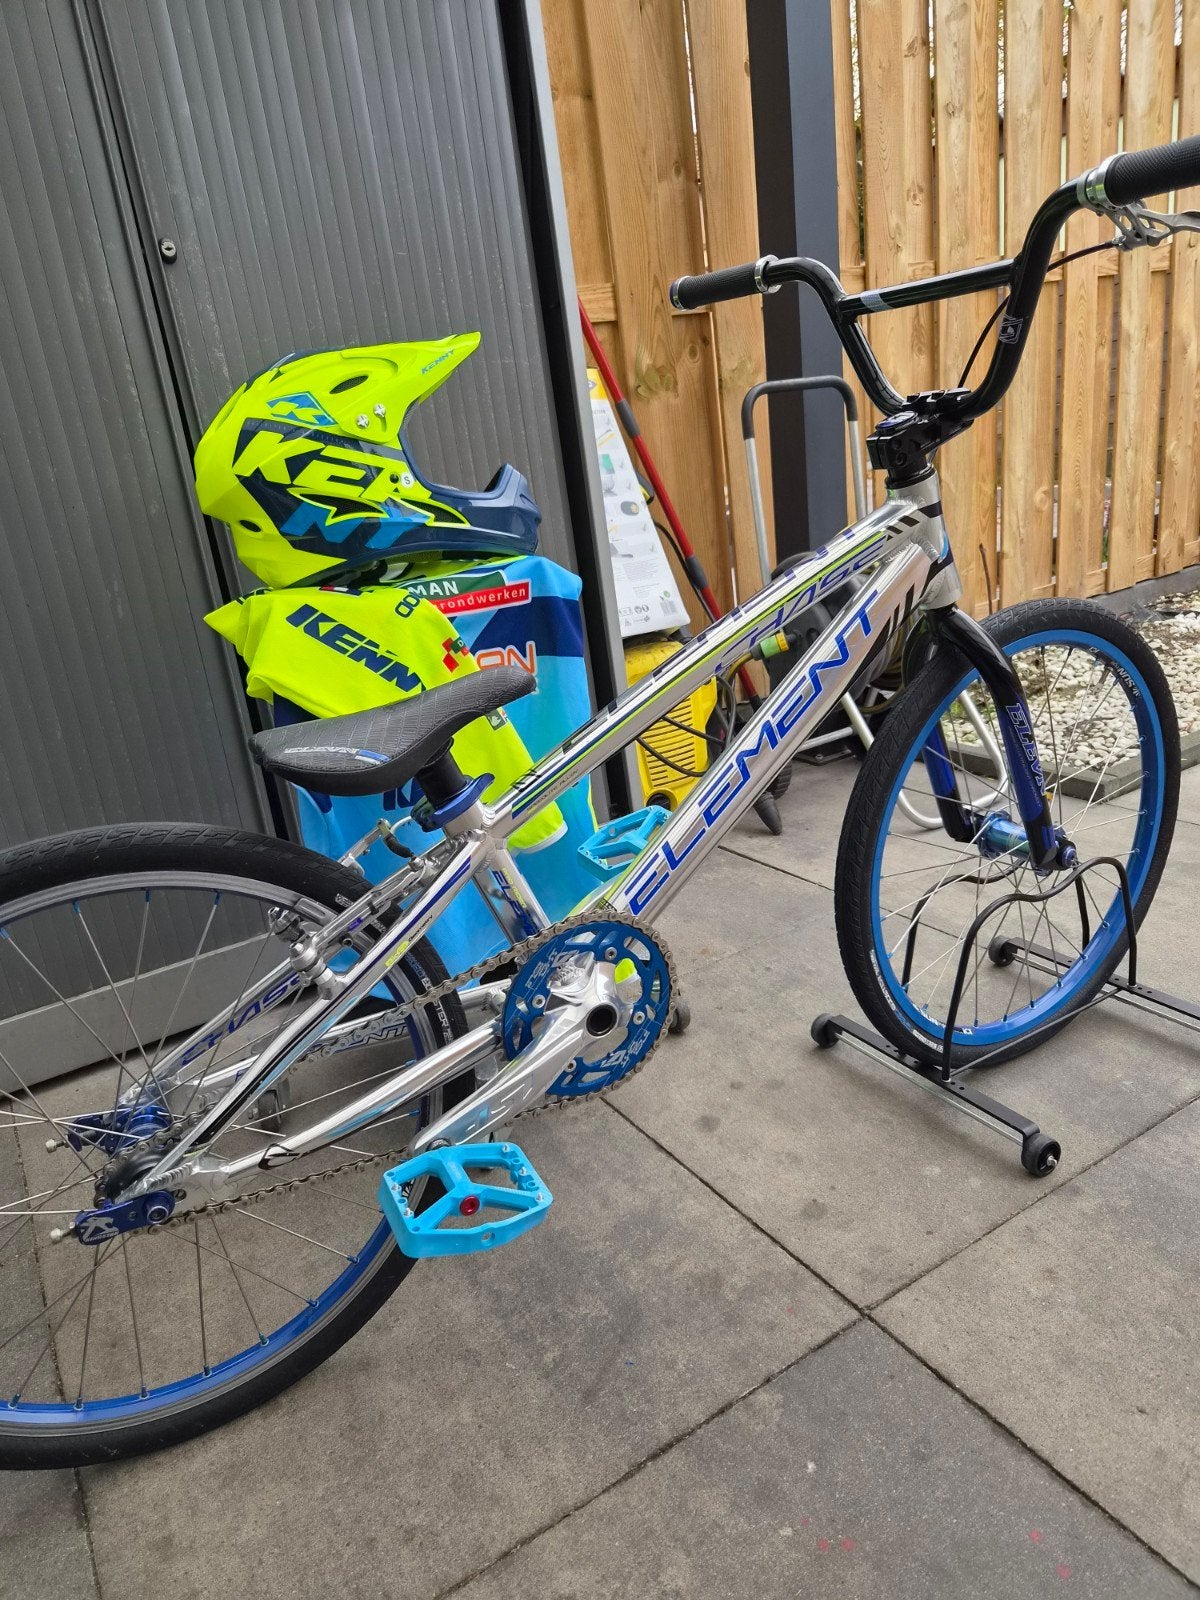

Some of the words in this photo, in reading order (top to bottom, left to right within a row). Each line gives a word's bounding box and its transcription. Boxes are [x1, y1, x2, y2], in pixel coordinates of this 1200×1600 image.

[420, 349, 455, 375] KENNY
[435, 588, 526, 611] rondwerken
[714, 536, 887, 674] CHASE
[285, 603, 426, 692] KENN
[624, 589, 879, 916] ELEMENT
[181, 971, 301, 1067] CHAS
